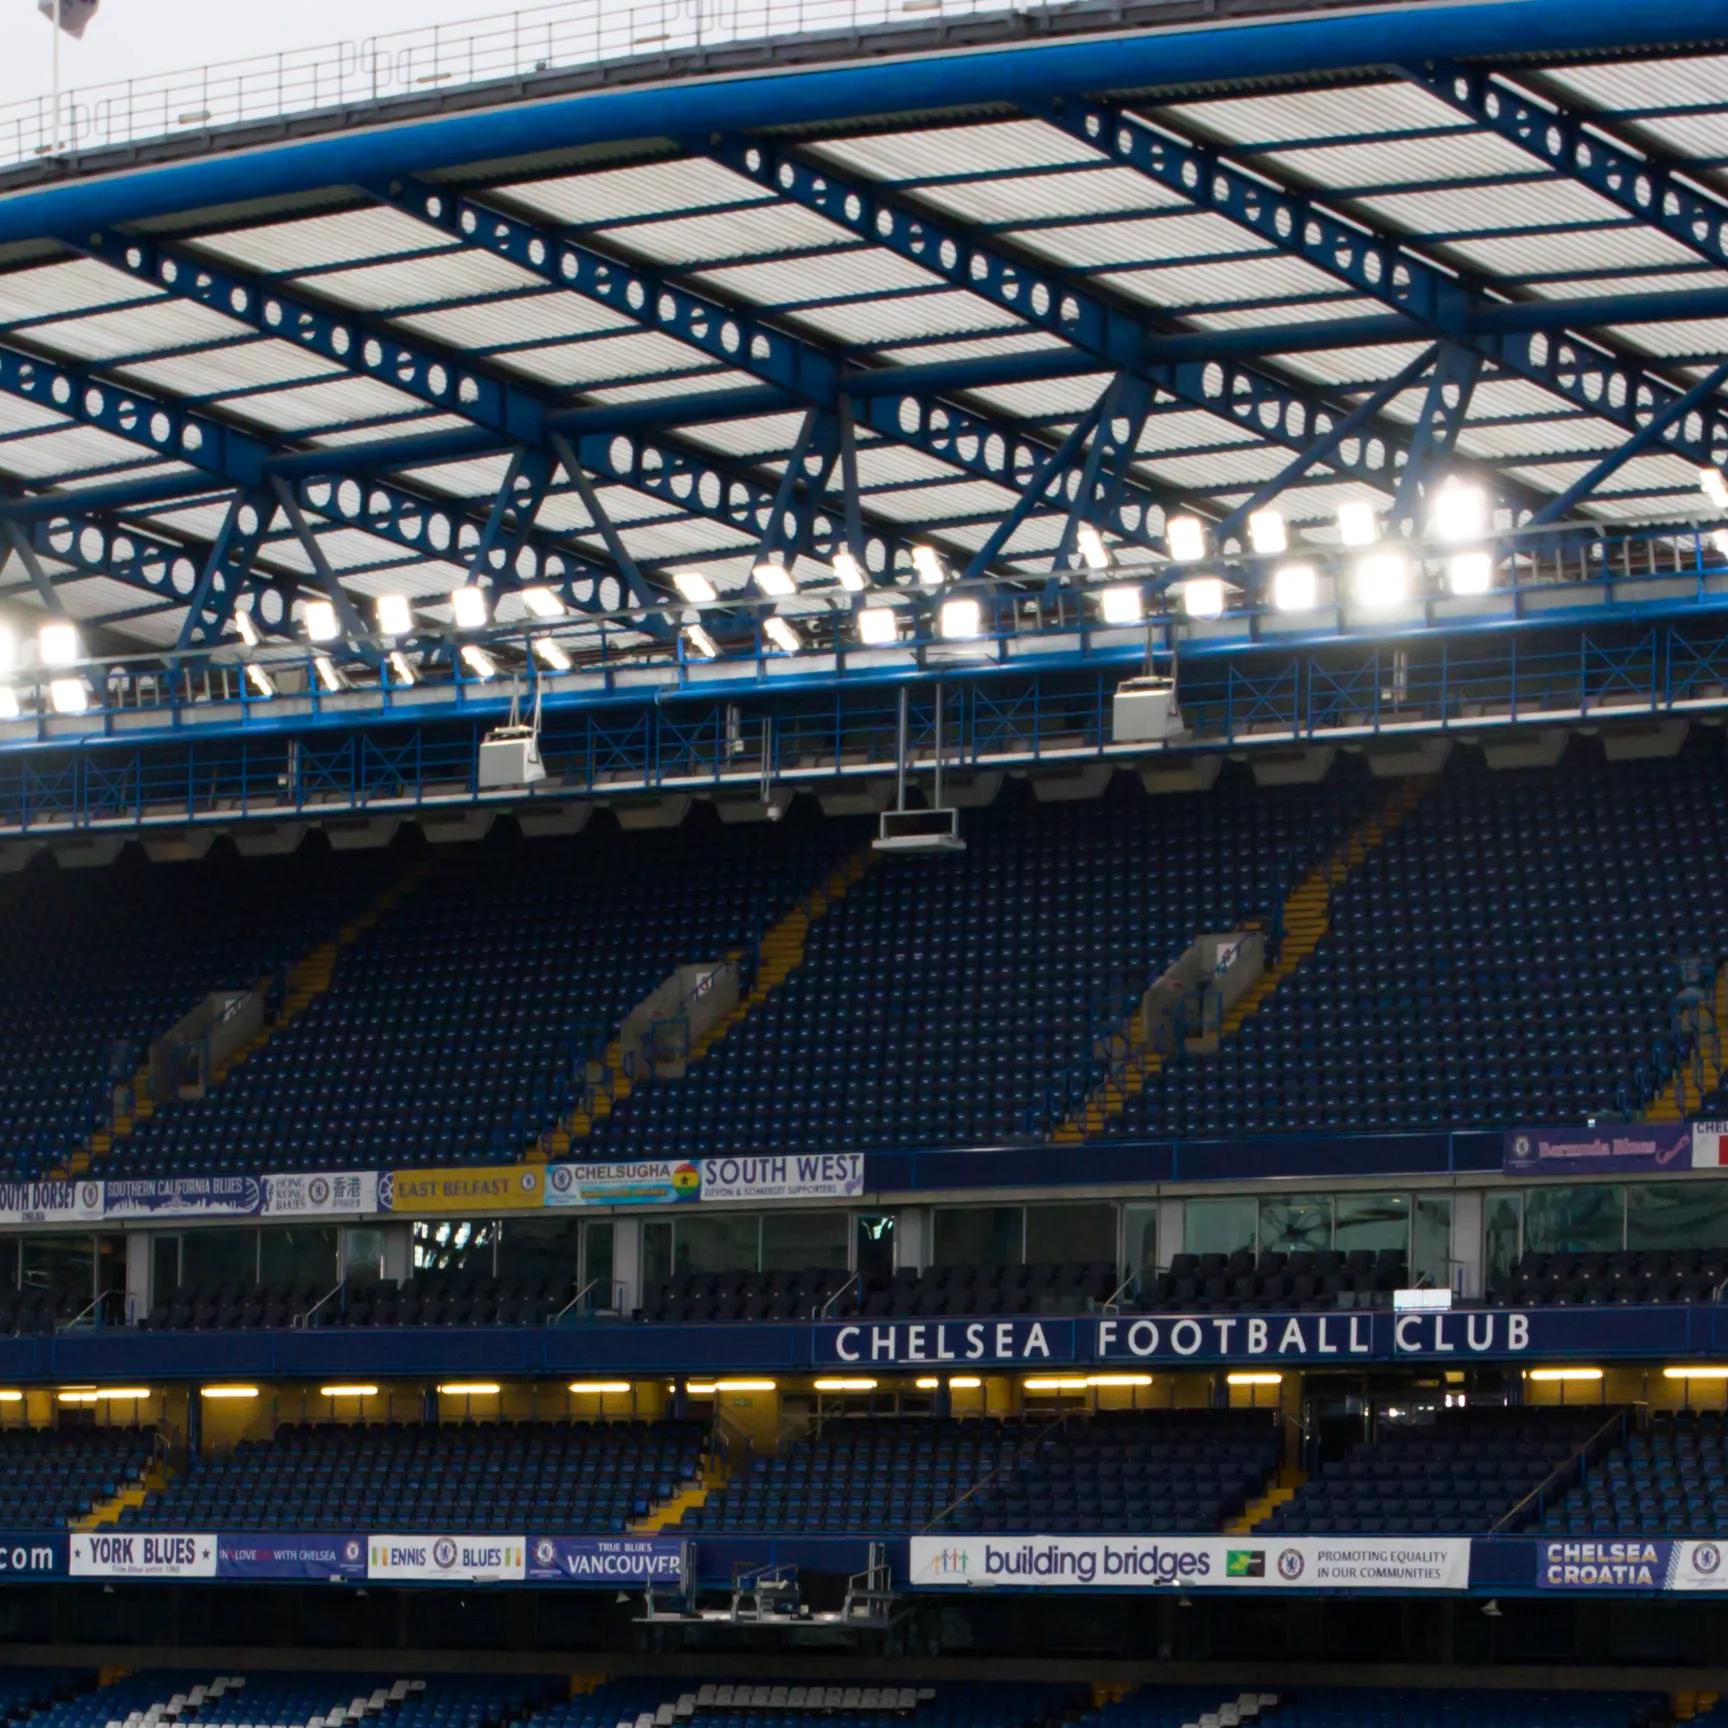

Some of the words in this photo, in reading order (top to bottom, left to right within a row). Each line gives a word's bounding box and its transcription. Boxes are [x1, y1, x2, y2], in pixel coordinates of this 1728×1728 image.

[575, 1165, 671, 1180] CHELSUGHA
[706, 1158, 786, 1184] SOUTH
[797, 1155, 860, 1182] WEST
[107, 1180, 155, 1197] SOUTHERN
[158, 1178, 210, 1196] CALIFORNIA
[213, 1177, 243, 1193] BLUES
[276, 1178, 305, 1188] HONG
[334, 1176, 360, 1197] 香港
[399, 1182, 438, 1197] EAST
[443, 1179, 510, 1195] BELFAST
[705, 1188, 733, 1197] DEVON
[744, 1187, 786, 1196] SOMERSET
[788, 1185, 837, 1195] SUPPORTERS
[276, 1189, 305, 1199] KONG
[276, 1199, 306, 1210] BLUES
[836, 1323, 1051, 1360] CHELSEA
[1099, 1319, 1369, 1357] FOOTBALL
[1396, 1315, 1529, 1352] CLUB
[90, 1538, 134, 1564] YORK
[143, 1538, 195, 1564] BLUES
[235, 1550, 256, 1560] LOVE
[274, 1550, 296, 1560] WITH
[299, 1550, 336, 1560] CHELSEA
[598, 1542, 621, 1552] TRUE
[624, 1542, 652, 1552] BLUES
[1547, 1544, 1658, 1563] CHELSEA
[391, 1548, 426, 1566] ENNIS
[463, 1548, 501, 1566] BLUES
[986, 1545, 1096, 1582] building
[1104, 1545, 1210, 1582] bridges
[1318, 1551, 1388, 1563] PROMOTING
[1390, 1551, 1447, 1563] EQUALITY
[1318, 1568, 1328, 1578] IN
[1331, 1568, 1357, 1579] OUR
[1360, 1568, 1441, 1579] COMMUNITIES
[1547, 1566, 1652, 1585] CROATIA
